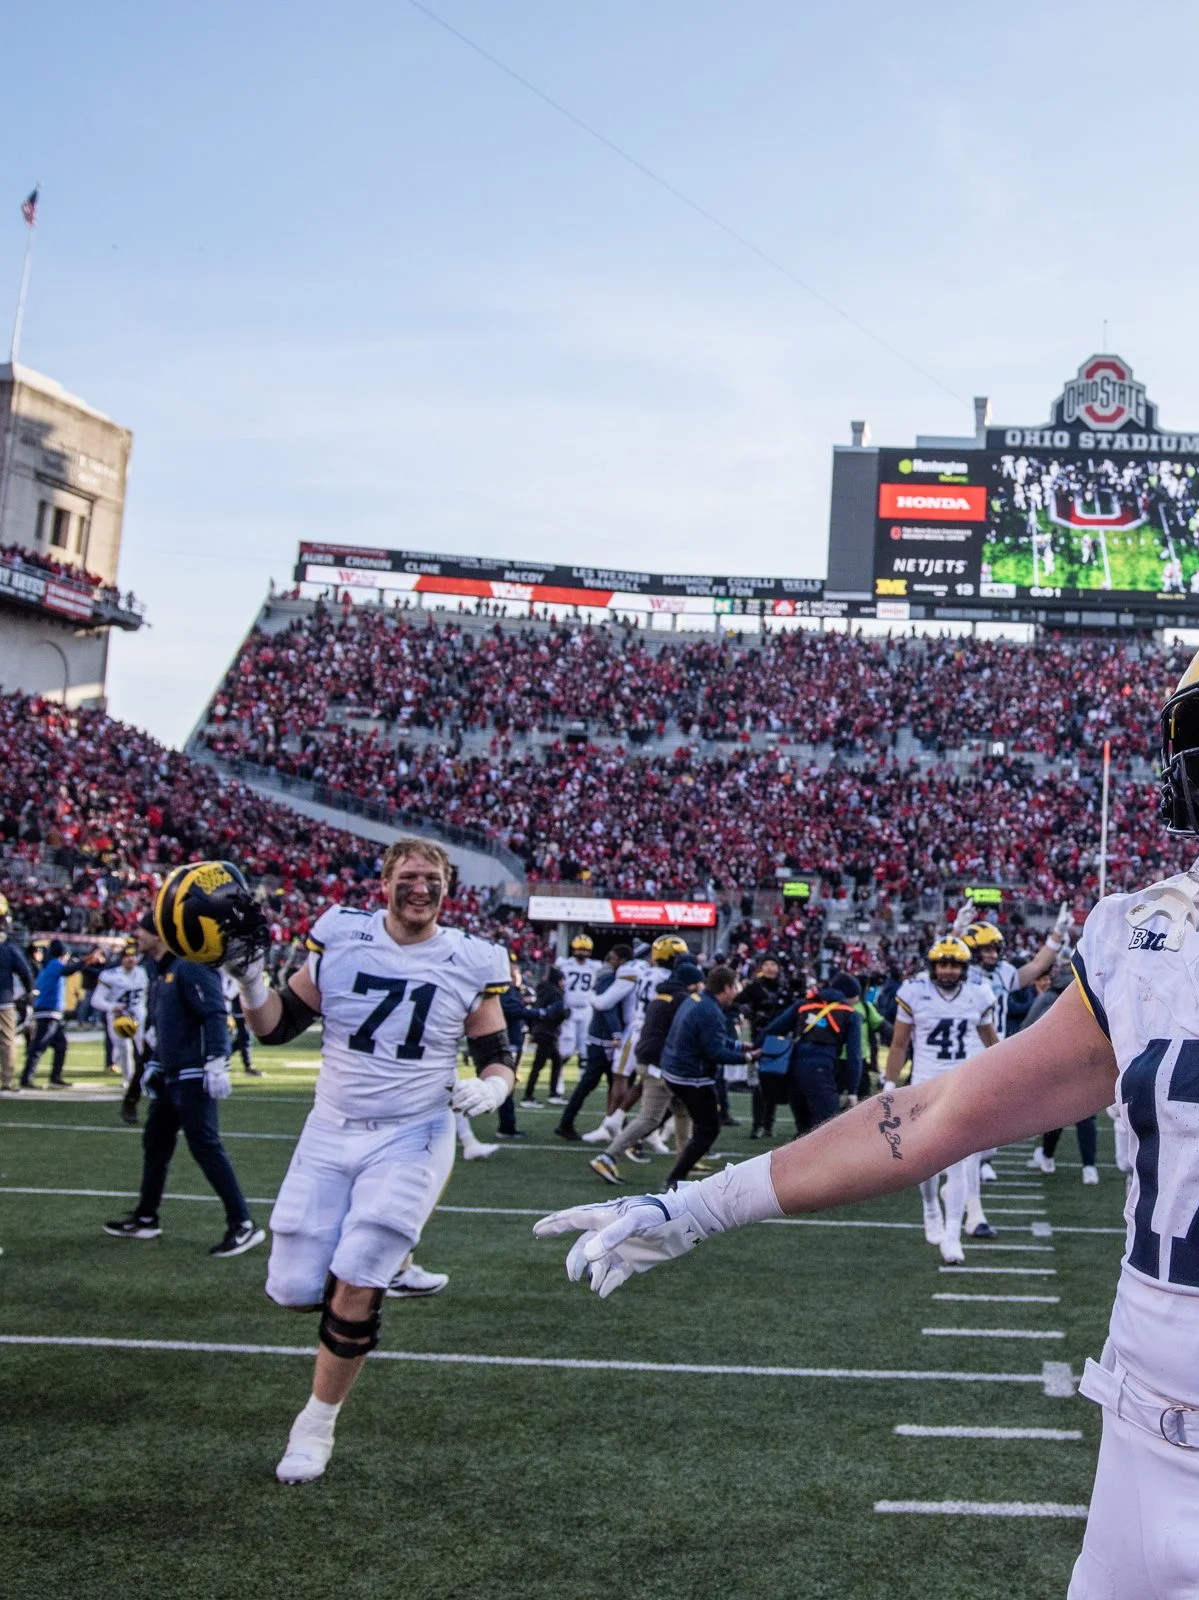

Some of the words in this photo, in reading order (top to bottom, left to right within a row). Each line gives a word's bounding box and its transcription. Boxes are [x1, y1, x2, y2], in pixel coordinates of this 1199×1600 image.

[1005, 429, 1070, 448] OHIO
[896, 496, 971, 510] HONDA
[345, 556, 393, 570] CRONIN
[404, 561, 441, 574] CLINE
[893, 558, 967, 576] NETJETS
[503, 570, 546, 583] McCOY
[875, 579, 907, 595] M
[568, 971, 592, 992] 79
[348, 971, 438, 1060] 71
[926, 1017, 968, 1060] 41
[878, 1116, 901, 1134] 2
[885, 1132, 903, 1160] Ball
